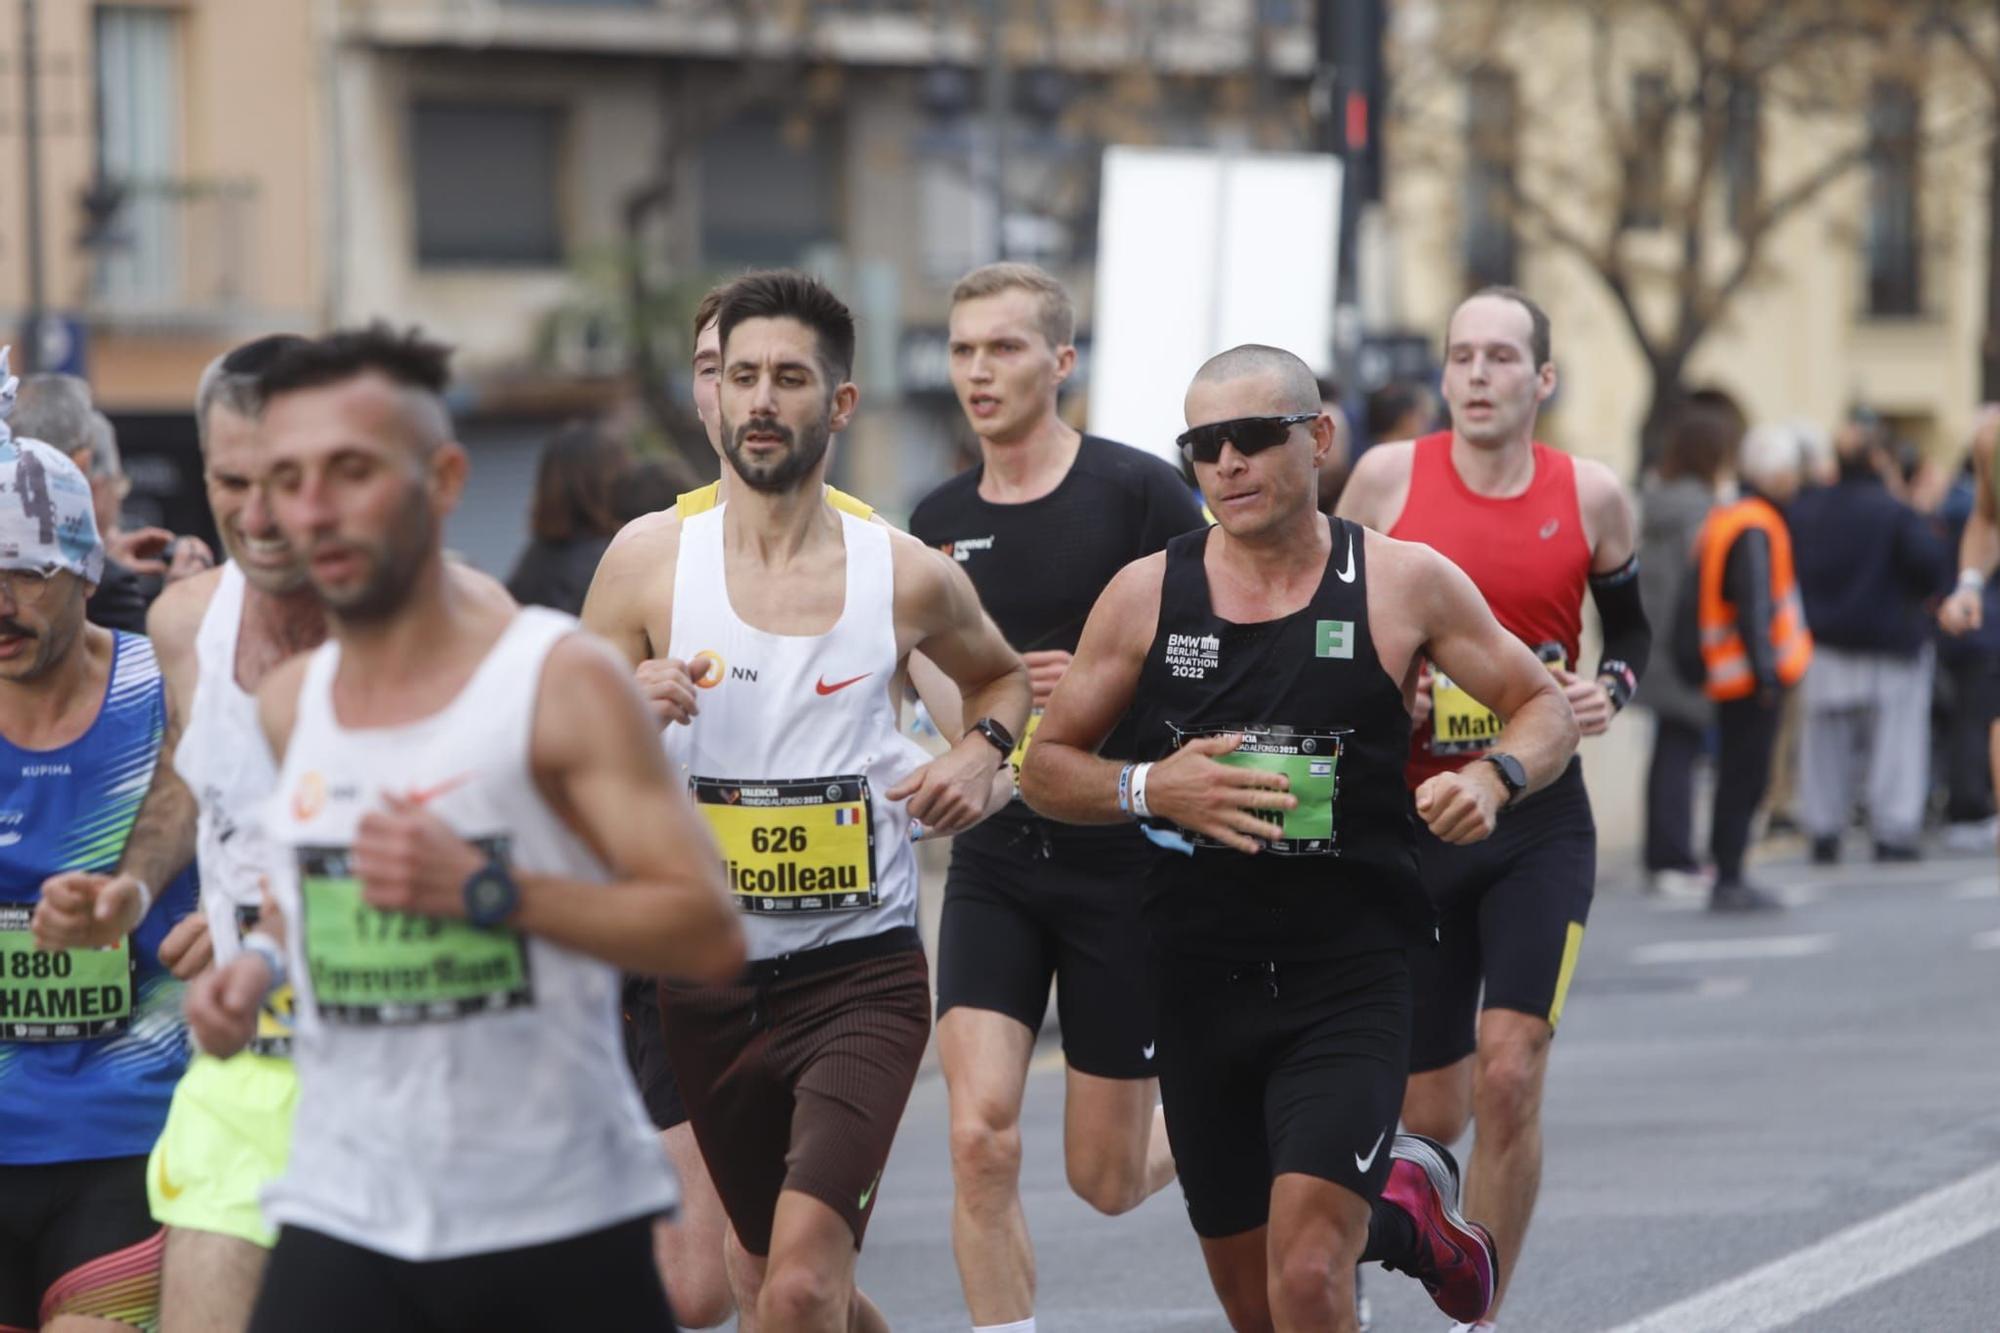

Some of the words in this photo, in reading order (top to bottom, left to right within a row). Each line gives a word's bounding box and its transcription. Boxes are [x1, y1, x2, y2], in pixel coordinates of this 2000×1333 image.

[1168, 634, 1200, 649] BMW
[1166, 647, 1199, 657] BERLIN
[1165, 655, 1218, 669] MARATHON
[731, 667, 758, 682] NN
[1172, 666, 1205, 679] 2022
[752, 826, 807, 853] 626
[722, 860, 858, 892] icolleau
